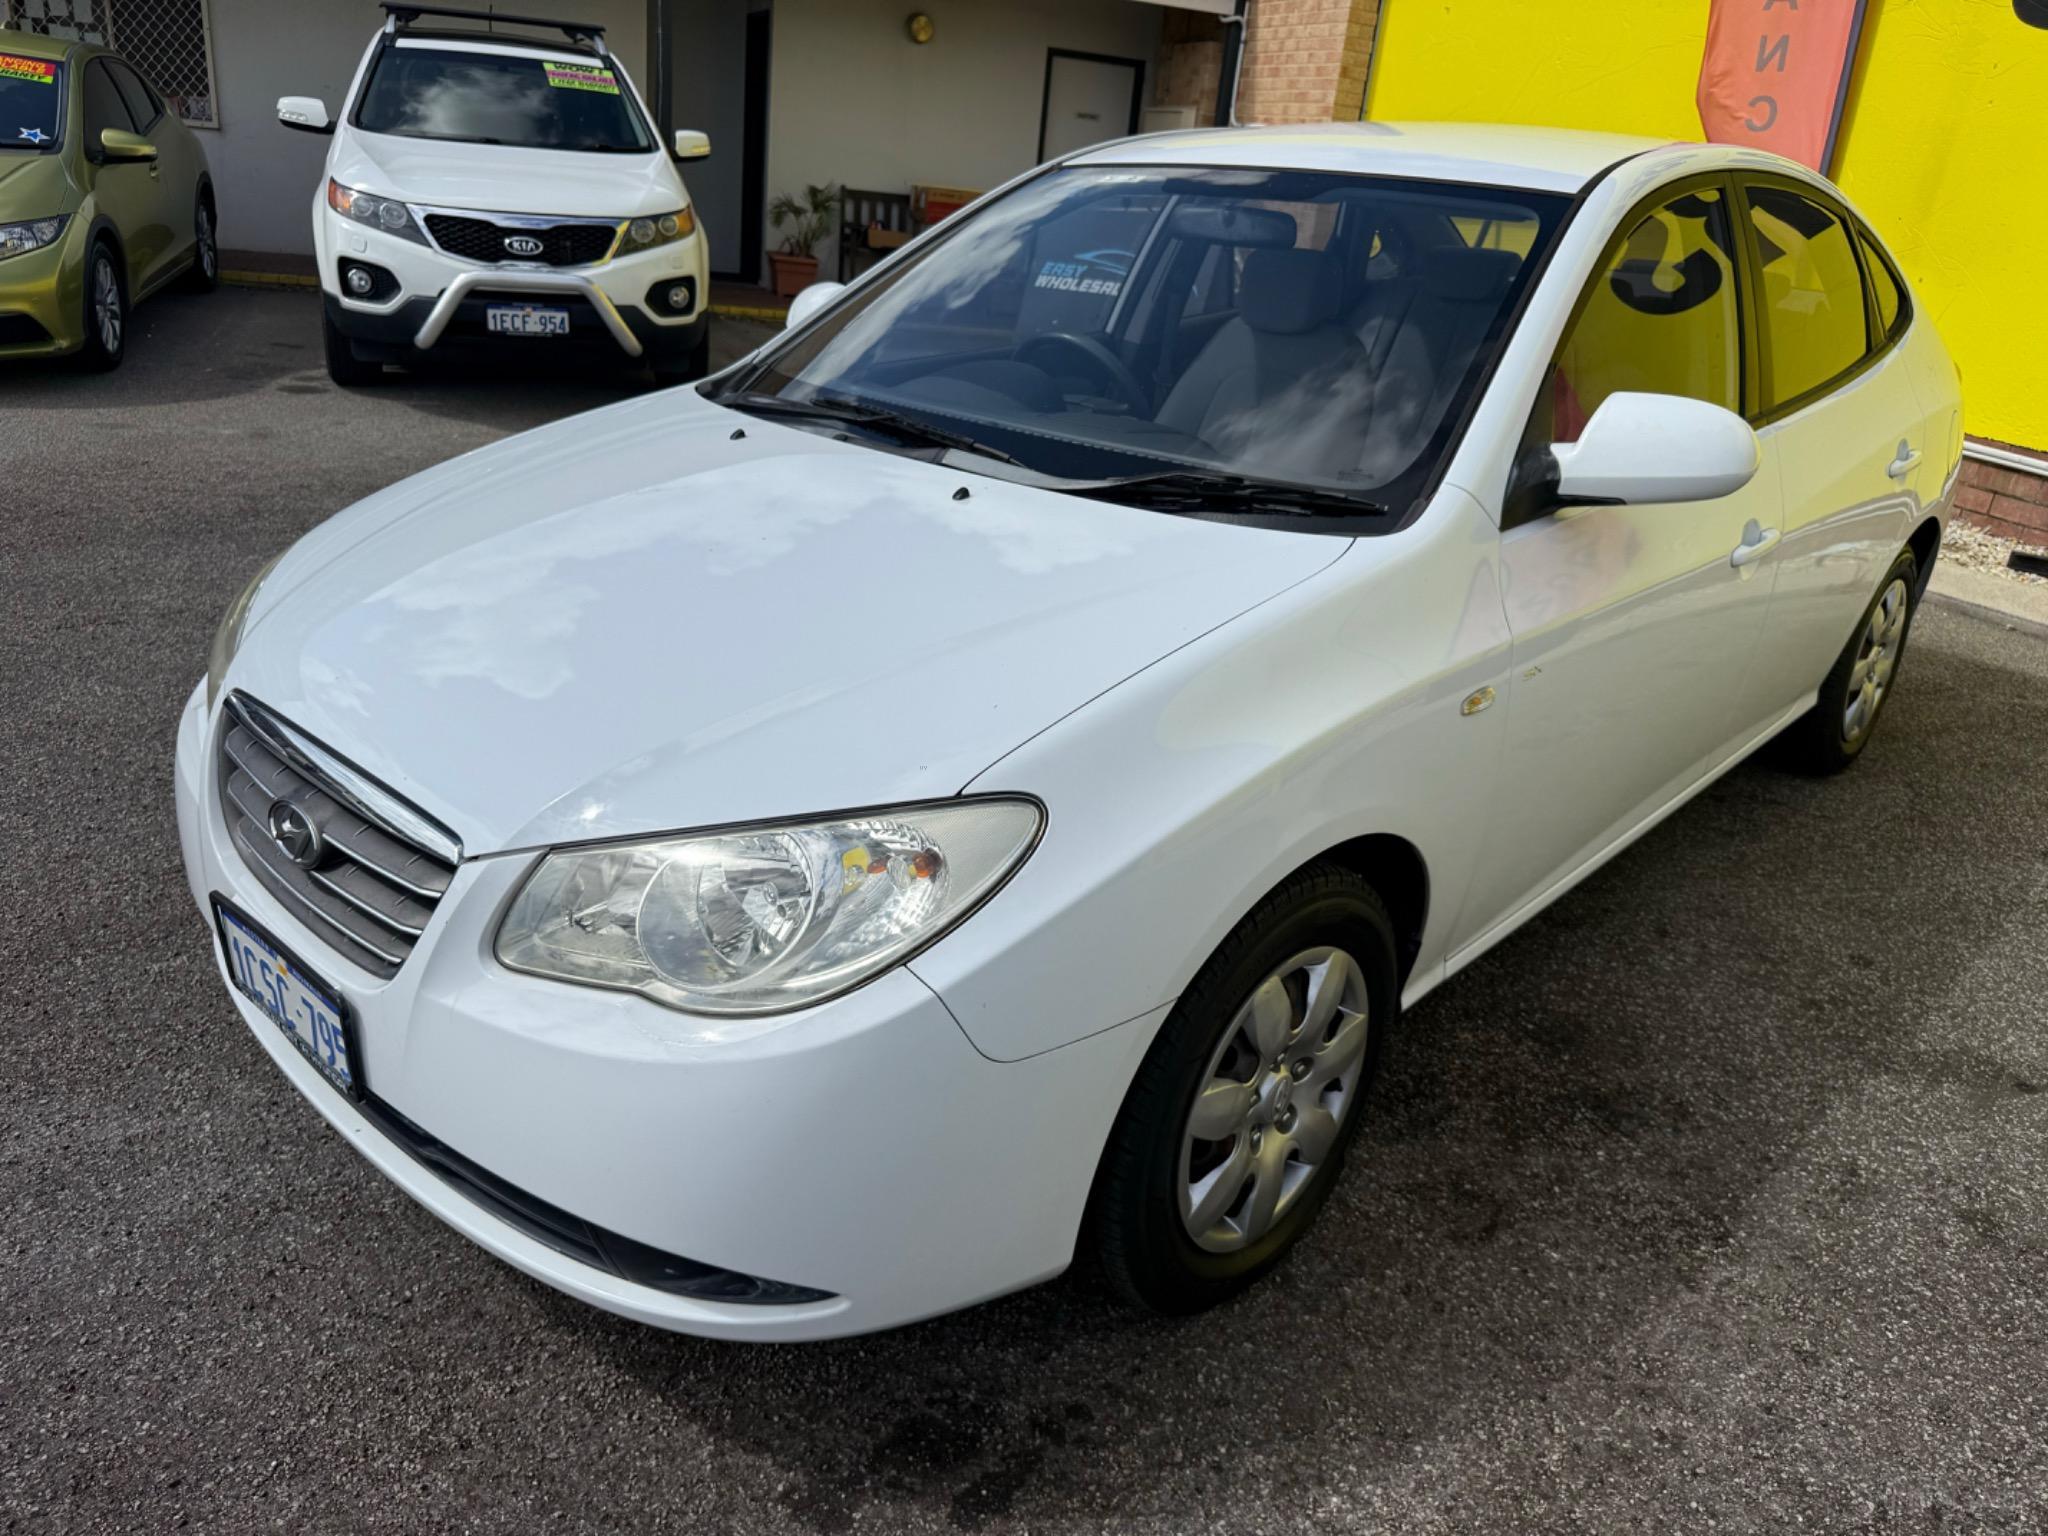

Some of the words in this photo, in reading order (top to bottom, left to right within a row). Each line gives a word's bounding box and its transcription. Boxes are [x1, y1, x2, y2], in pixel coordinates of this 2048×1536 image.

[511, 240, 536, 252] KIA
[1041, 261, 1088, 277] EASY
[1035, 274, 1121, 296] WHOLESAL
